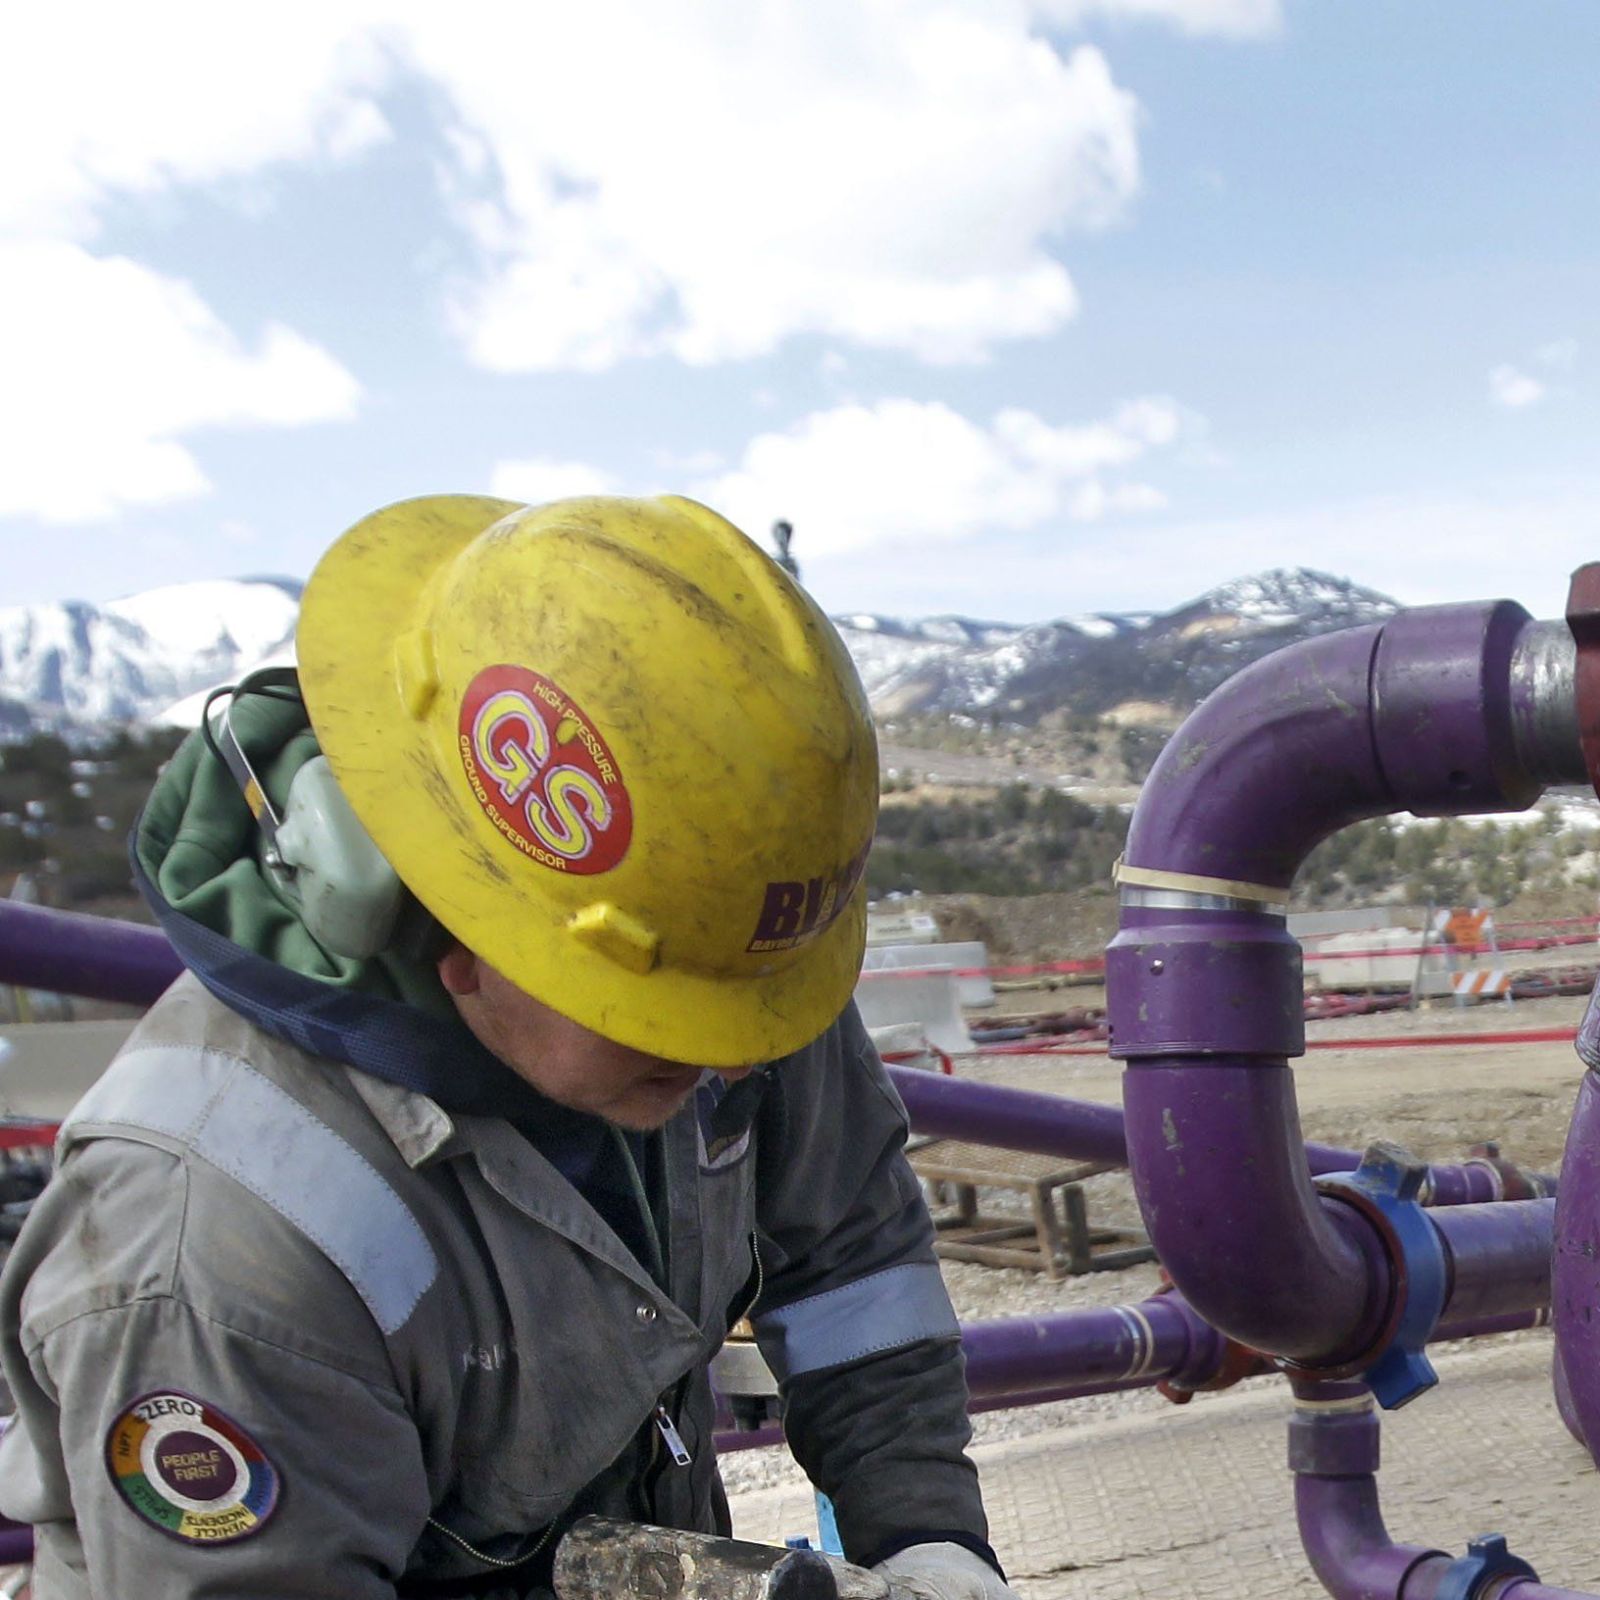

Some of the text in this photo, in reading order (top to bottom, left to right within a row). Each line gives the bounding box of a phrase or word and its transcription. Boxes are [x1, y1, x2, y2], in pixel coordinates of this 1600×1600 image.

[532, 680, 567, 716] HIGH
[472, 689, 616, 861] GS
[458, 733, 568, 870] GROUND SUPERVISOR
[139, 1399, 196, 1420] ZERO
[161, 1449, 222, 1470] PEOPLE
[173, 1465, 218, 1482] FIRST
[184, 1506, 249, 1526] INCIDENTS
[193, 1520, 252, 1538] VEHICLE
